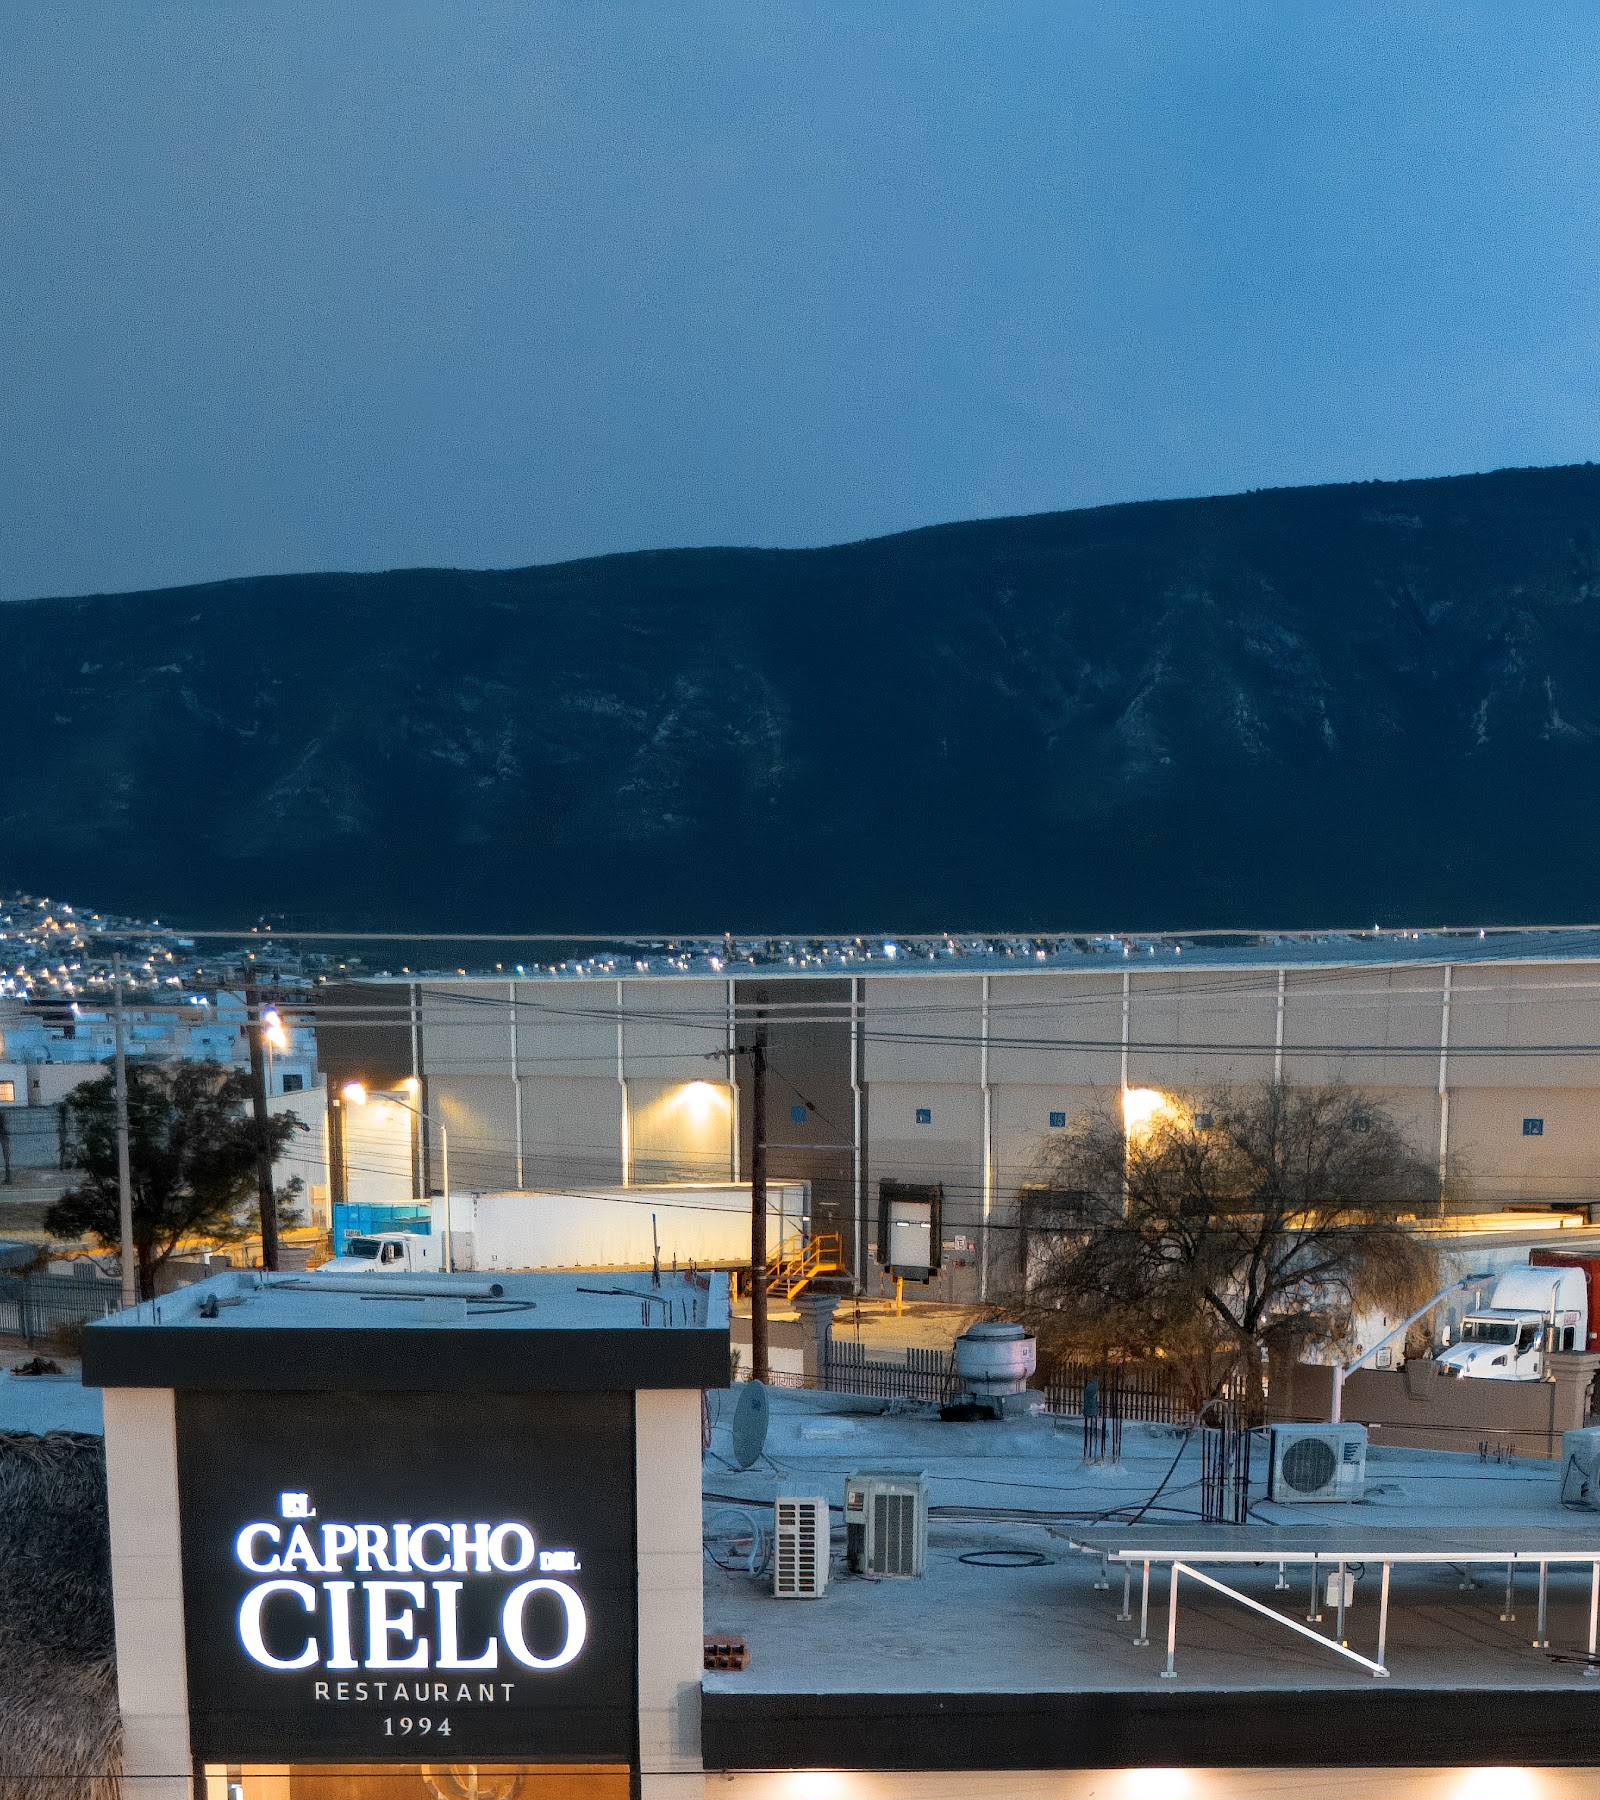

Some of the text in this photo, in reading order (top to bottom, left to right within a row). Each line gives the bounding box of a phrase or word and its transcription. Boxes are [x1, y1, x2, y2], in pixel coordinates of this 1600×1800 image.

[1529, 1121, 1540, 1134] 12
[281, 1492, 316, 1518] EL
[236, 1521, 581, 1573] CAPRICHO DEL
[237, 1578, 587, 1670] CIELO
[314, 1681, 516, 1703] RESTAURANT
[382, 1717, 453, 1737] 1994
